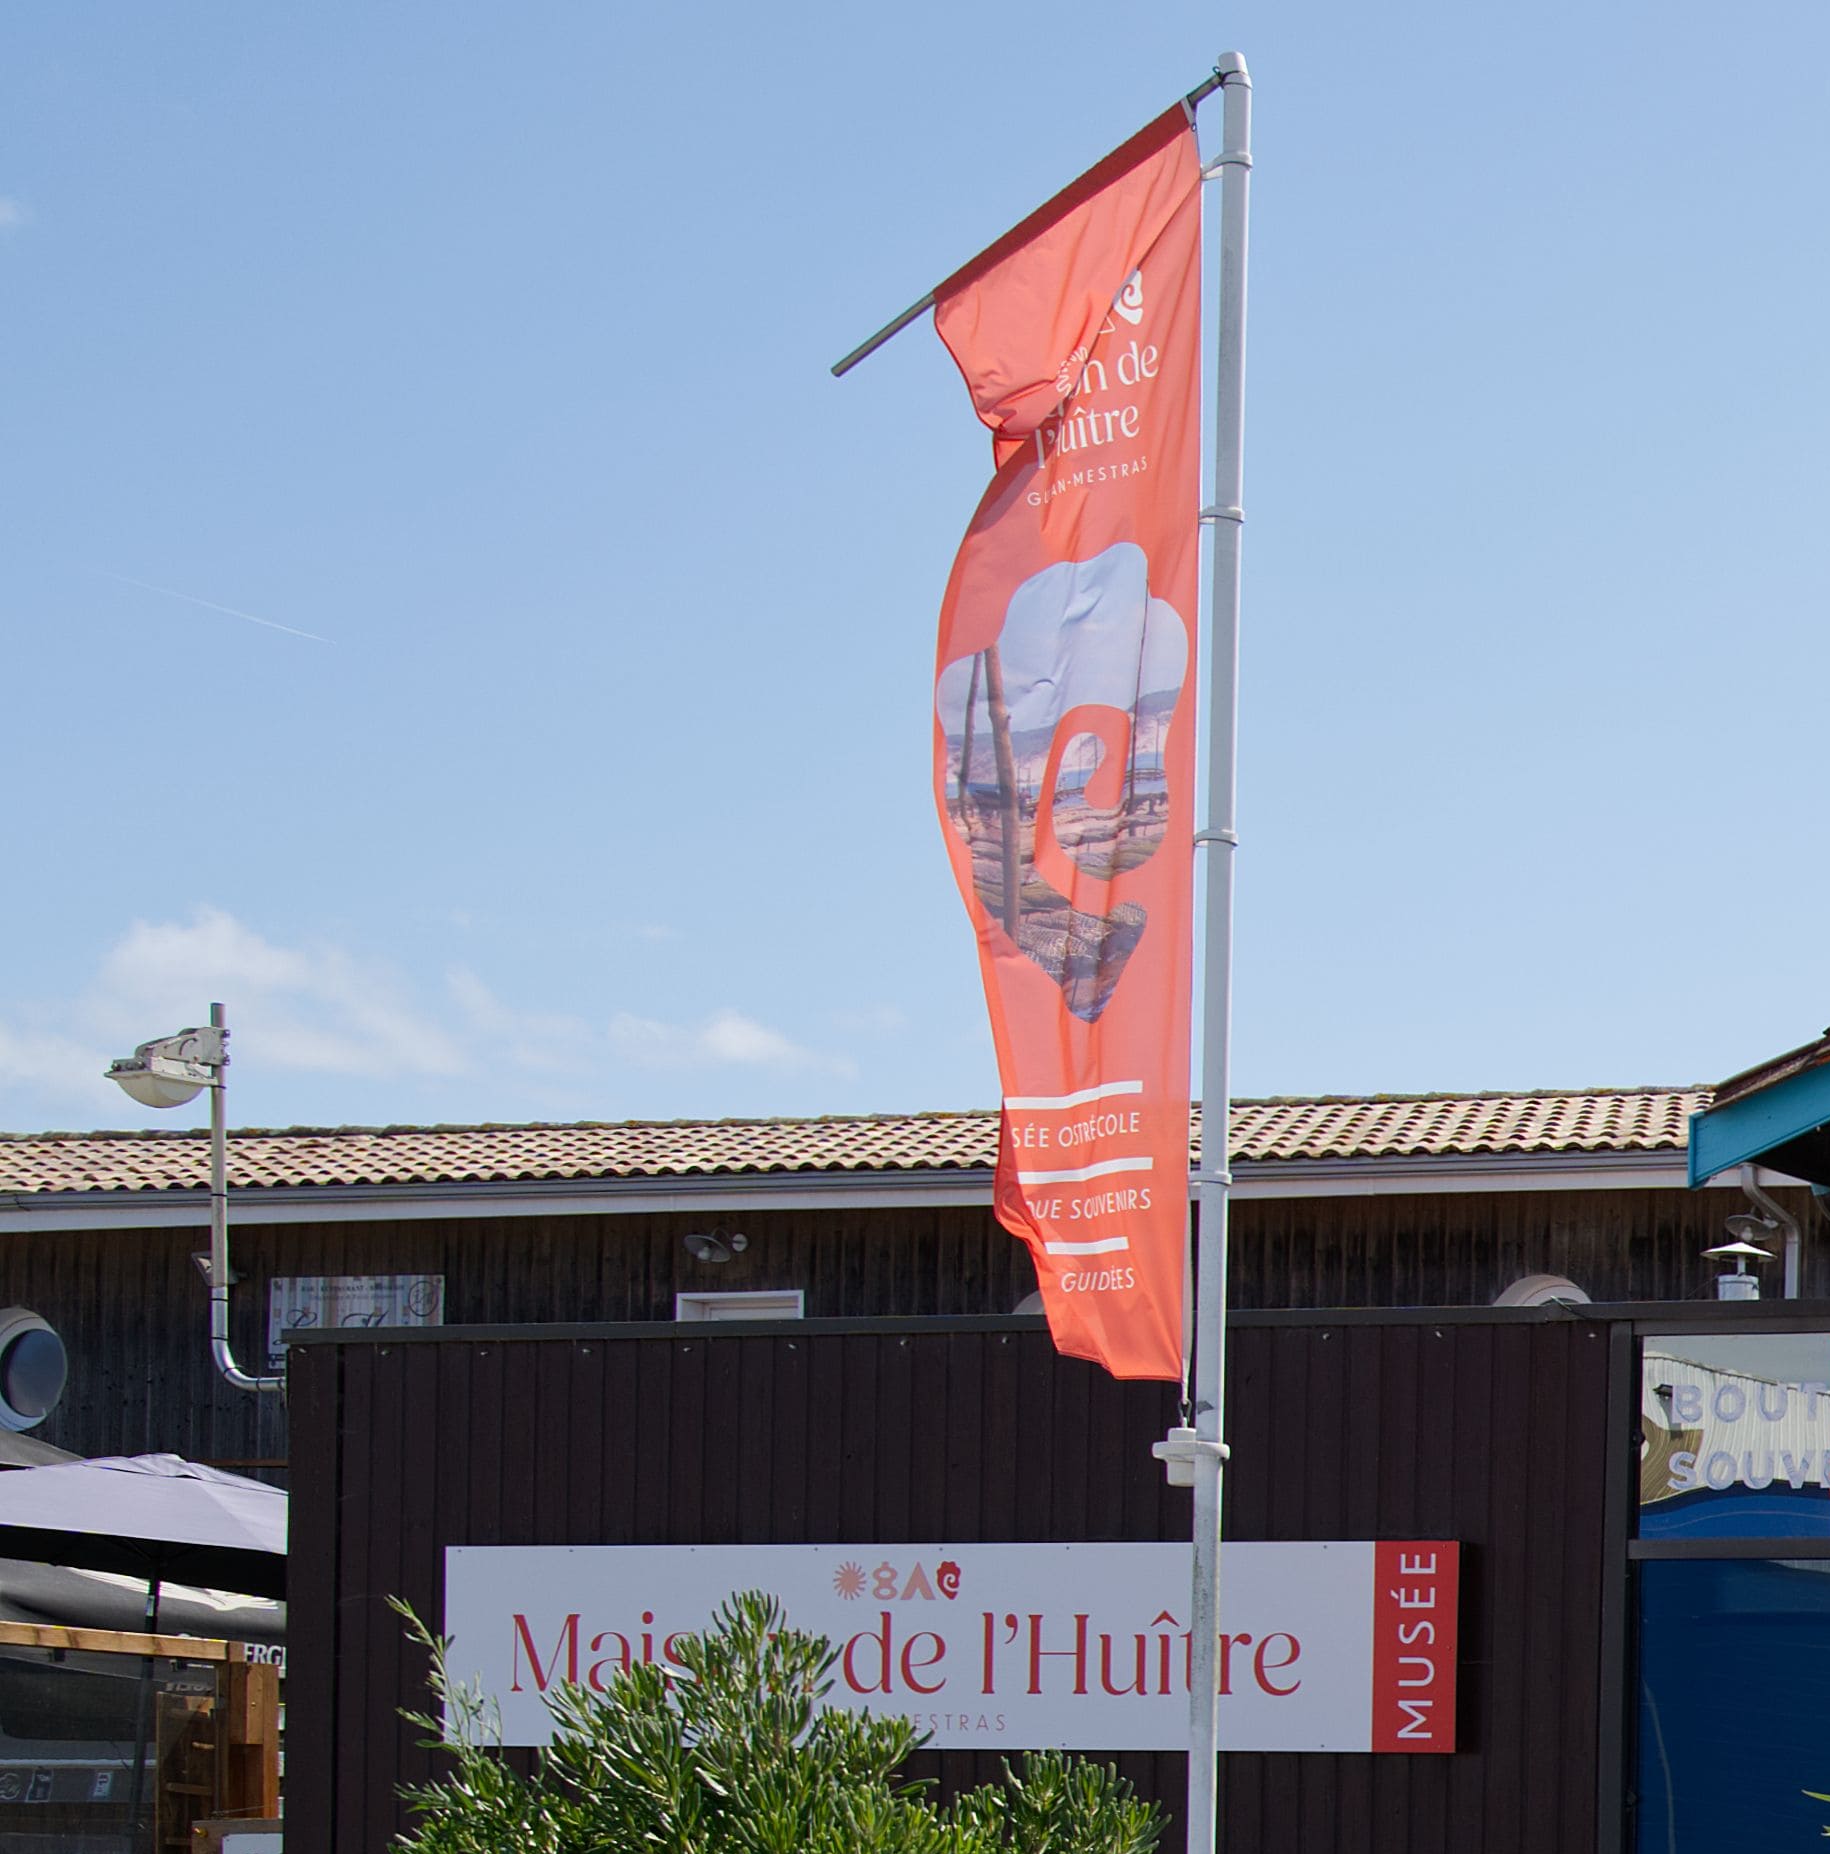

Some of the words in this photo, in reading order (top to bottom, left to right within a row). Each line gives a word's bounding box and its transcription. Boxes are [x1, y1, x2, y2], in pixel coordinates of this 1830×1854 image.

[1011, 1122, 1050, 1149] SÉE
[1069, 1188, 1152, 1220] SOUVENIRS
[842, 1611, 947, 1695] de
[1396, 1550, 1438, 1740] MUSÉE
